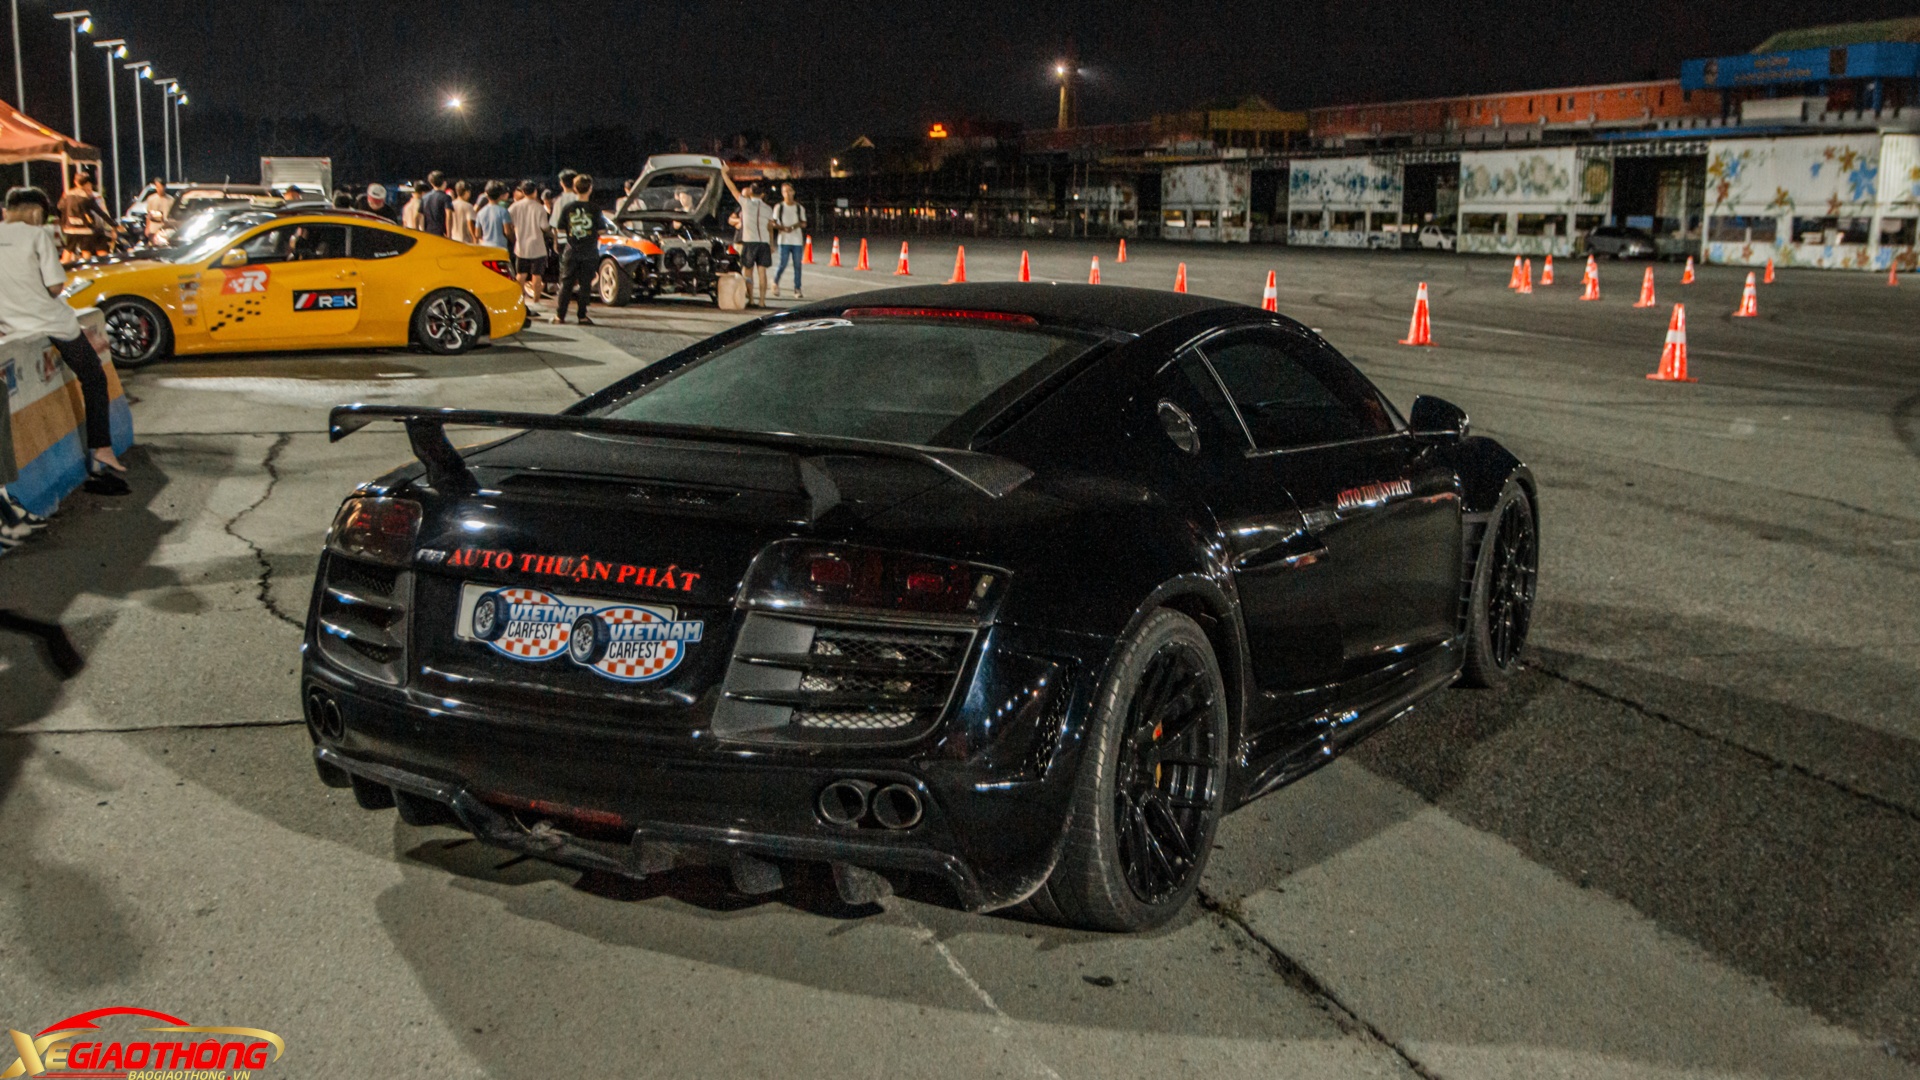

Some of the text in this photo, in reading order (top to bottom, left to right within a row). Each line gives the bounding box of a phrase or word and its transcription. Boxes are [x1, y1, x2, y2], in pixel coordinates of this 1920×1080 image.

[318, 294, 356, 308] RSK
[448, 548, 513, 570] AUTO
[520, 553, 613, 582] THUẬN
[617, 563, 700, 591] PHÁT
[507, 621, 556, 640] CARFEST
[610, 622, 701, 642] VIETNAM
[609, 641, 661, 660] CARFEST
